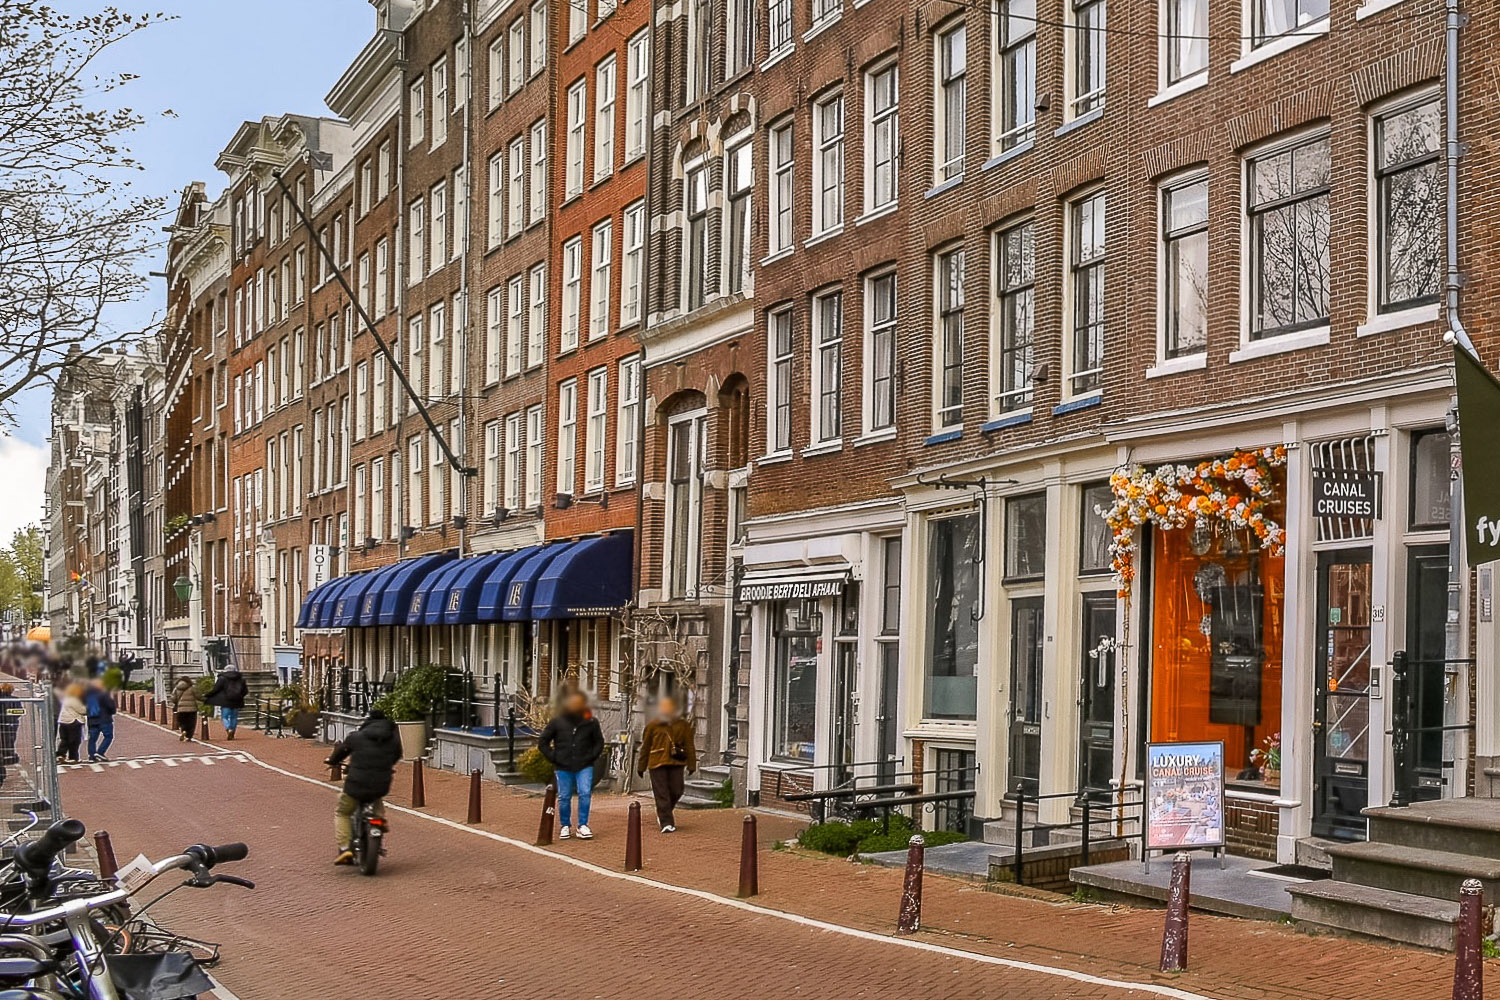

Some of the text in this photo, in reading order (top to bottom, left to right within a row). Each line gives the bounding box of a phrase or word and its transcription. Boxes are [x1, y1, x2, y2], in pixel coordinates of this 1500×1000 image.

[1323, 482, 1366, 497] CANAL
[1317, 499, 1371, 515] CRUISES
[740, 582, 842, 601] BROODJE BERT DELI AFHAAL
[1373, 609, 1384, 619] 315
[1153, 754, 1200, 768] LUXURY
[1153, 766, 1214, 777] CANAL CRUISE
